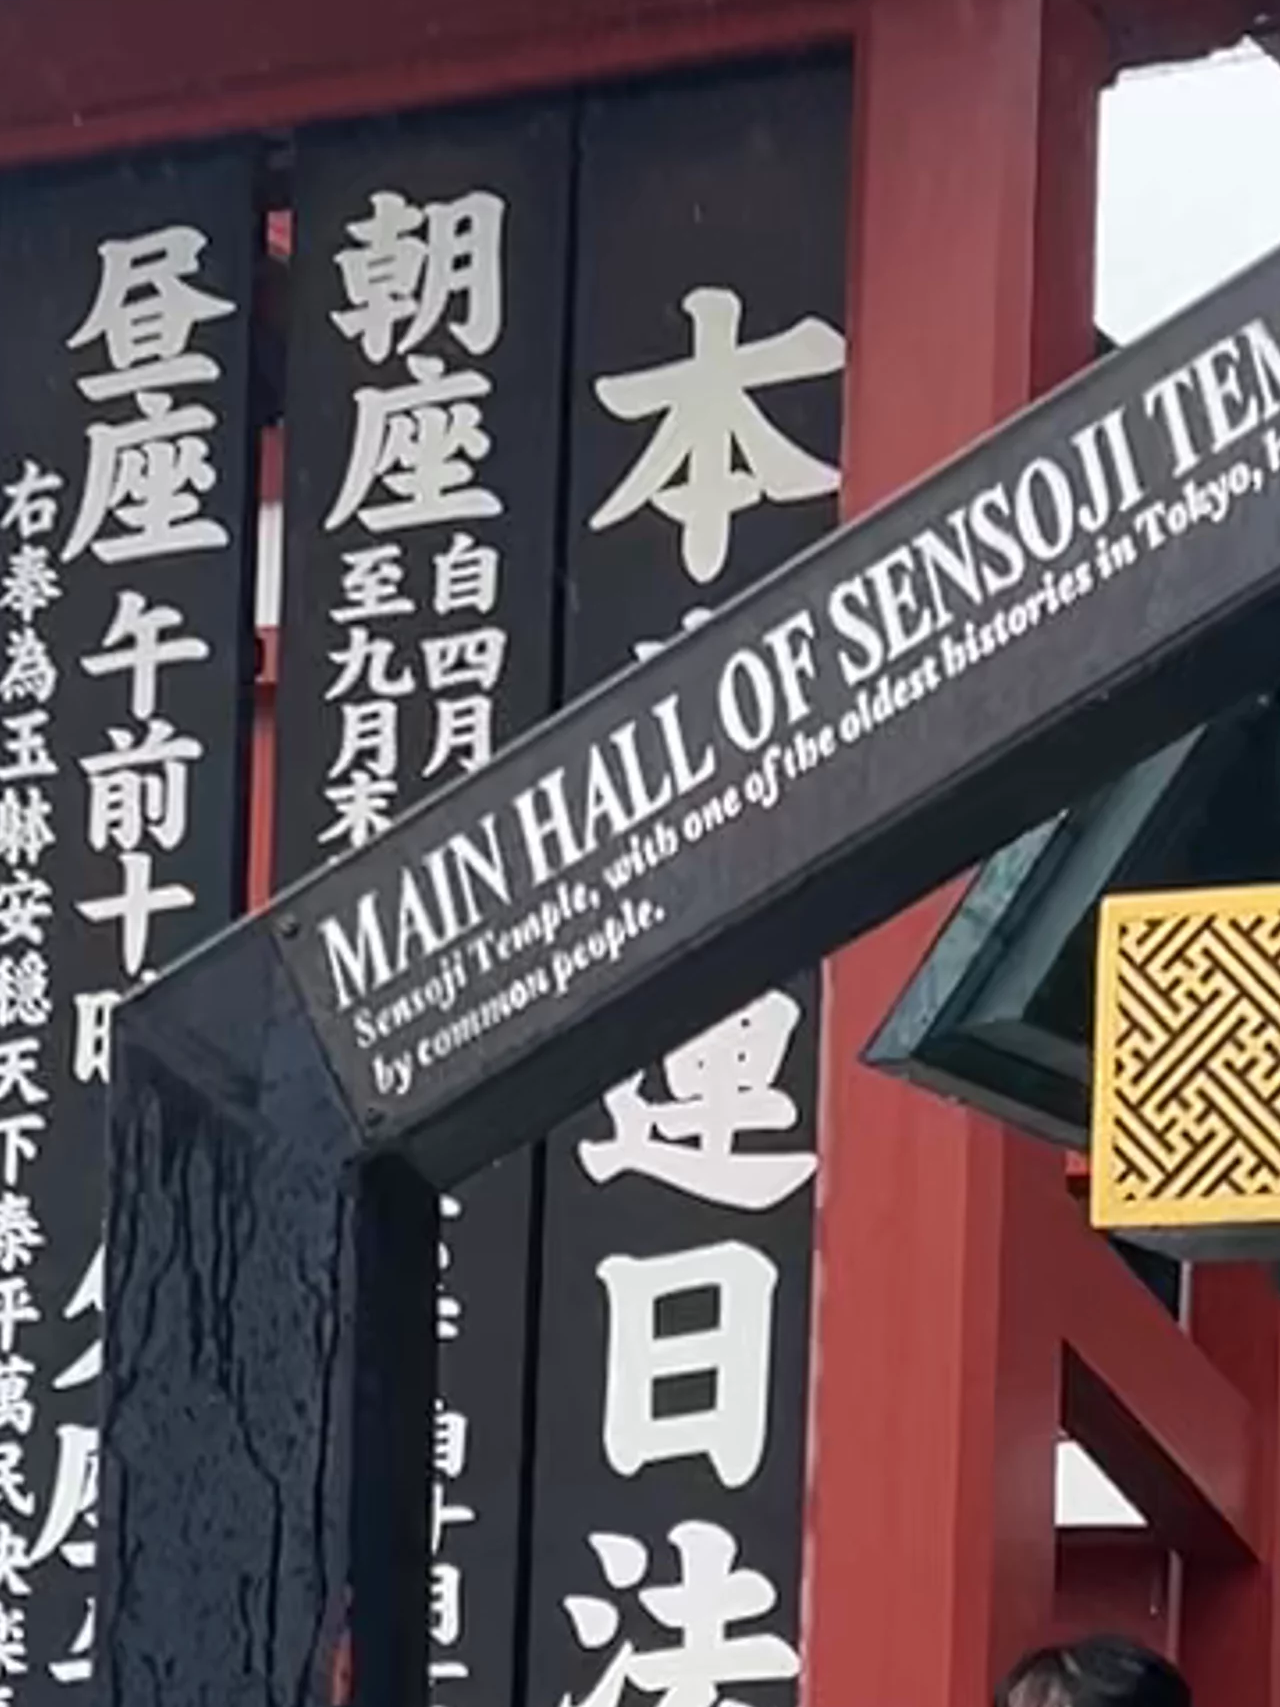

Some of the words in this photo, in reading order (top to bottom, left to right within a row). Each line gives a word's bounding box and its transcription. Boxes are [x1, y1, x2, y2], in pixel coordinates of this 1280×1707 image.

[60, 224, 238, 565] 昼座
[323, 189, 506, 533] 朝座
[319, 812, 511, 1009] MAIN
[512, 693, 716, 891] HALL
[717, 609, 817, 749] OF
[835, 404, 1145, 685] SENSOJI
[352, 957, 465, 1050] Sensoji
[468, 880, 601, 978] Temple,
[603, 825, 680, 891] with
[683, 790, 741, 842] one
[743, 746, 786, 808] of
[780, 721, 836, 779] the
[838, 659, 941, 746] oldest
[942, 561, 1094, 682] histories
[1095, 537, 1136, 580] in
[1134, 457, 1264, 550] Tokyo,
[373, 1055, 413, 1095] by
[417, 965, 550, 1069] common
[550, 902, 666, 992] people.
